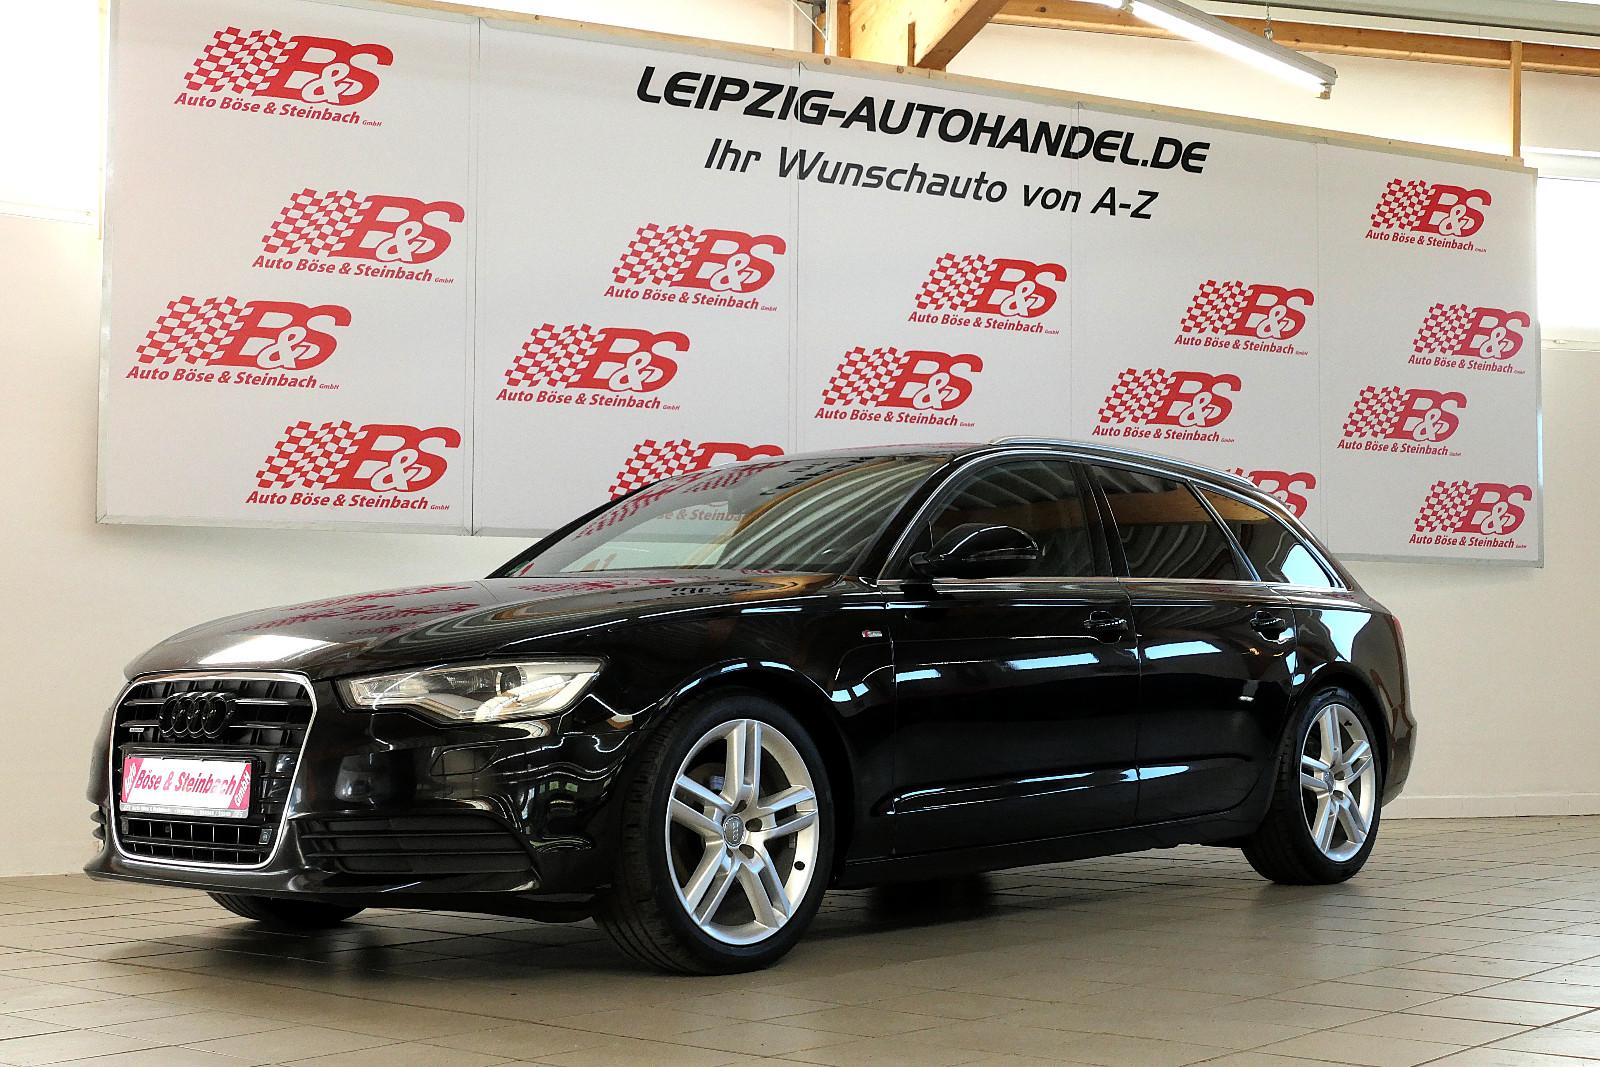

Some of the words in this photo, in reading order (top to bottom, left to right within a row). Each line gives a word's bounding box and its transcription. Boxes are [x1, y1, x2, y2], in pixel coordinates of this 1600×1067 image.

[174, 92, 217, 108] Auto
[219, 97, 260, 113] Böse
[263, 102, 276, 115] &
[279, 103, 360, 125] Steinbach
[362, 119, 382, 127] GmbH
[636, 65, 1211, 174] LEIPZIG-AUTOHANDEL.DE
[704, 138, 762, 173] Ihr
[778, 146, 1008, 203] Wunschauto
[1023, 184, 1082, 213] von
[1090, 186, 1160, 219] A-Z
[1365, 229, 1390, 241] Auto
[1391, 232, 1415, 244] Böse
[1416, 235, 1424, 245] &
[1426, 236, 1473, 252] Steinbach
[251, 255, 293, 270] Auto
[295, 258, 336, 274] Böse
[338, 262, 351, 275] &
[354, 263, 432, 282] Steinbach
[603, 285, 639, 300] Auto
[641, 288, 676, 302] Böse
[678, 292, 689, 304] &
[691, 292, 759, 310] Steinbach
[907, 311, 939, 324] Auto
[940, 314, 970, 327] Böse
[972, 317, 982, 328] &
[984, 317, 1043, 334] Steinbach
[1174, 334, 1202, 347] Auto
[1203, 336, 1230, 349] Böse
[1232, 339, 1240, 350] &
[1242, 340, 1294, 355] Steinbach
[1407, 354, 1432, 366] Auto
[1433, 356, 1457, 368] Böse
[1458, 359, 1465, 369] &
[1467, 359, 1513, 374] Steinbach
[125, 366, 169, 381] Auto
[172, 368, 214, 383] Böse
[217, 371, 230, 384] &
[234, 371, 317, 389] Steinbach
[495, 388, 533, 402] Auto
[536, 390, 572, 404] Böse
[574, 393, 586, 405] &
[589, 393, 661, 410] Steinbach
[814, 407, 848, 420] Auto
[849, 409, 881, 422] Böse
[883, 411, 893, 423] &
[896, 411, 958, 427] Steinbach
[1091, 425, 1121, 437] Auto
[1122, 426, 1151, 438] Böse
[1152, 428, 1162, 439] &
[1163, 428, 1219, 443] Steinbach
[1337, 439, 1363, 450] Auto
[1364, 440, 1389, 452] Böse
[1390, 442, 1398, 452] &
[1400, 442, 1448, 456] Steinbach
[245, 490, 287, 505] Auto
[290, 492, 330, 506] Böse
[333, 494, 345, 507] &
[348, 494, 428, 510] Steinbach
[1408, 534, 1433, 545] Auto
[1434, 535, 1458, 546] Böse
[1459, 536, 1466, 546] &
[1468, 536, 1515, 549] Steinbach
[135, 769, 162, 791] Böse
[163, 771, 175, 791] &
